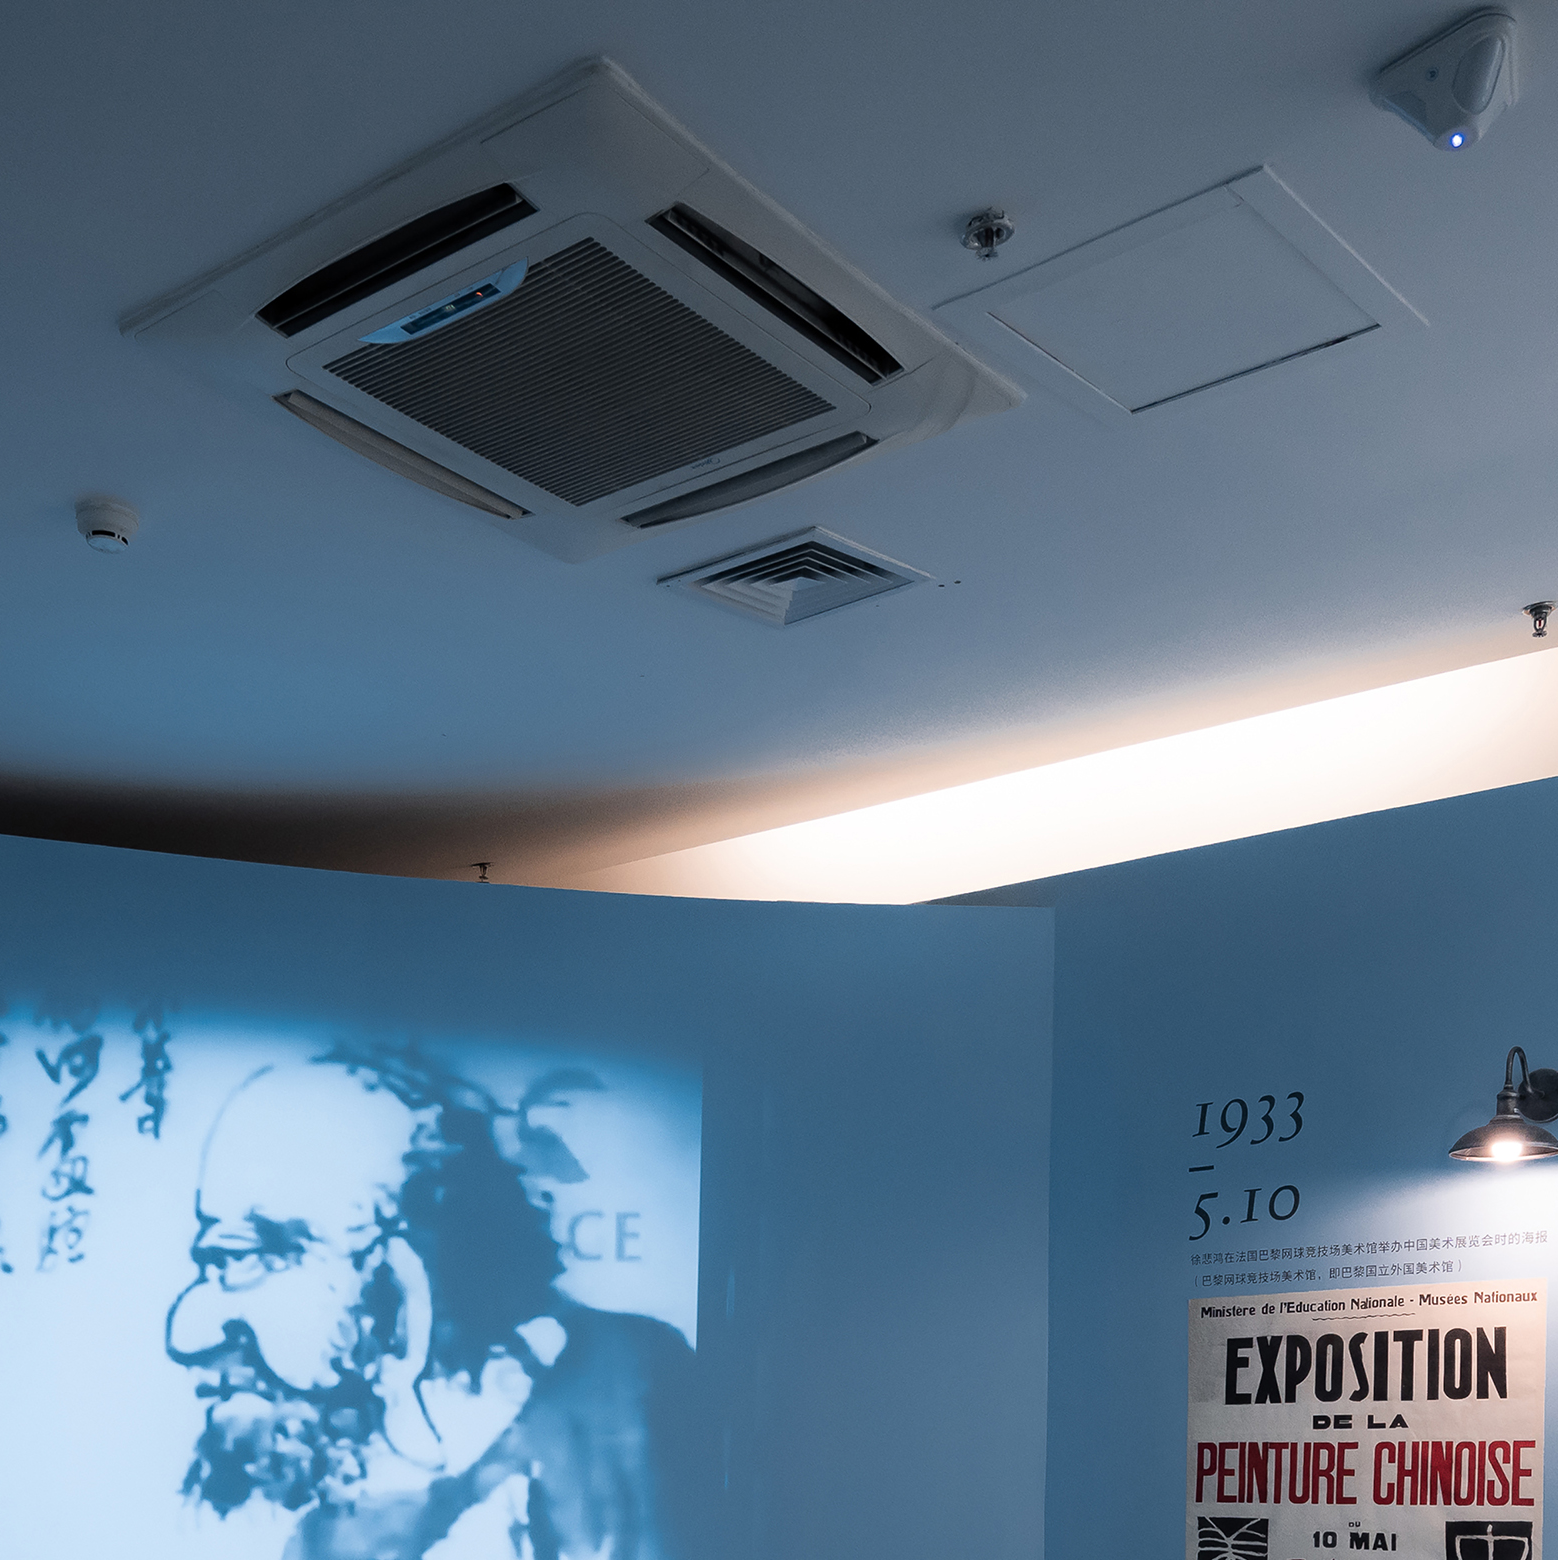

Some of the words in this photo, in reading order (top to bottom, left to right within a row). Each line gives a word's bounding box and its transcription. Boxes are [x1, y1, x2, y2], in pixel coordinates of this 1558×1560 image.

[1192, 1091, 1304, 1149] 1933
[1189, 1185, 1300, 1241] 5.10
[1190, 1230, 1548, 1266] 徐悲鸿在法国巴黎网球竞技场美术馆举办中国美术展览会时的海报
[1194, 1259, 1463, 1288] （巴黎网球竞技场美术馆，即巴黎国立外国美术馆）
[1200, 1304, 1256, 1319] Ministère
[1262, 1303, 1275, 1315] de
[1351, 1295, 1405, 1311] Nationale
[1419, 1293, 1468, 1305] Musées
[1474, 1290, 1538, 1304] Nationaux
[1225, 1326, 1508, 1405] EXPOSITION
[1313, 1415, 1353, 1429] DE
[1367, 1414, 1409, 1429] LA
[1195, 1441, 1359, 1505] PEINTURE
[1373, 1440, 1536, 1507] CHINOISE
[1313, 1531, 1338, 1548] 10
[1349, 1532, 1397, 1551] MAI
